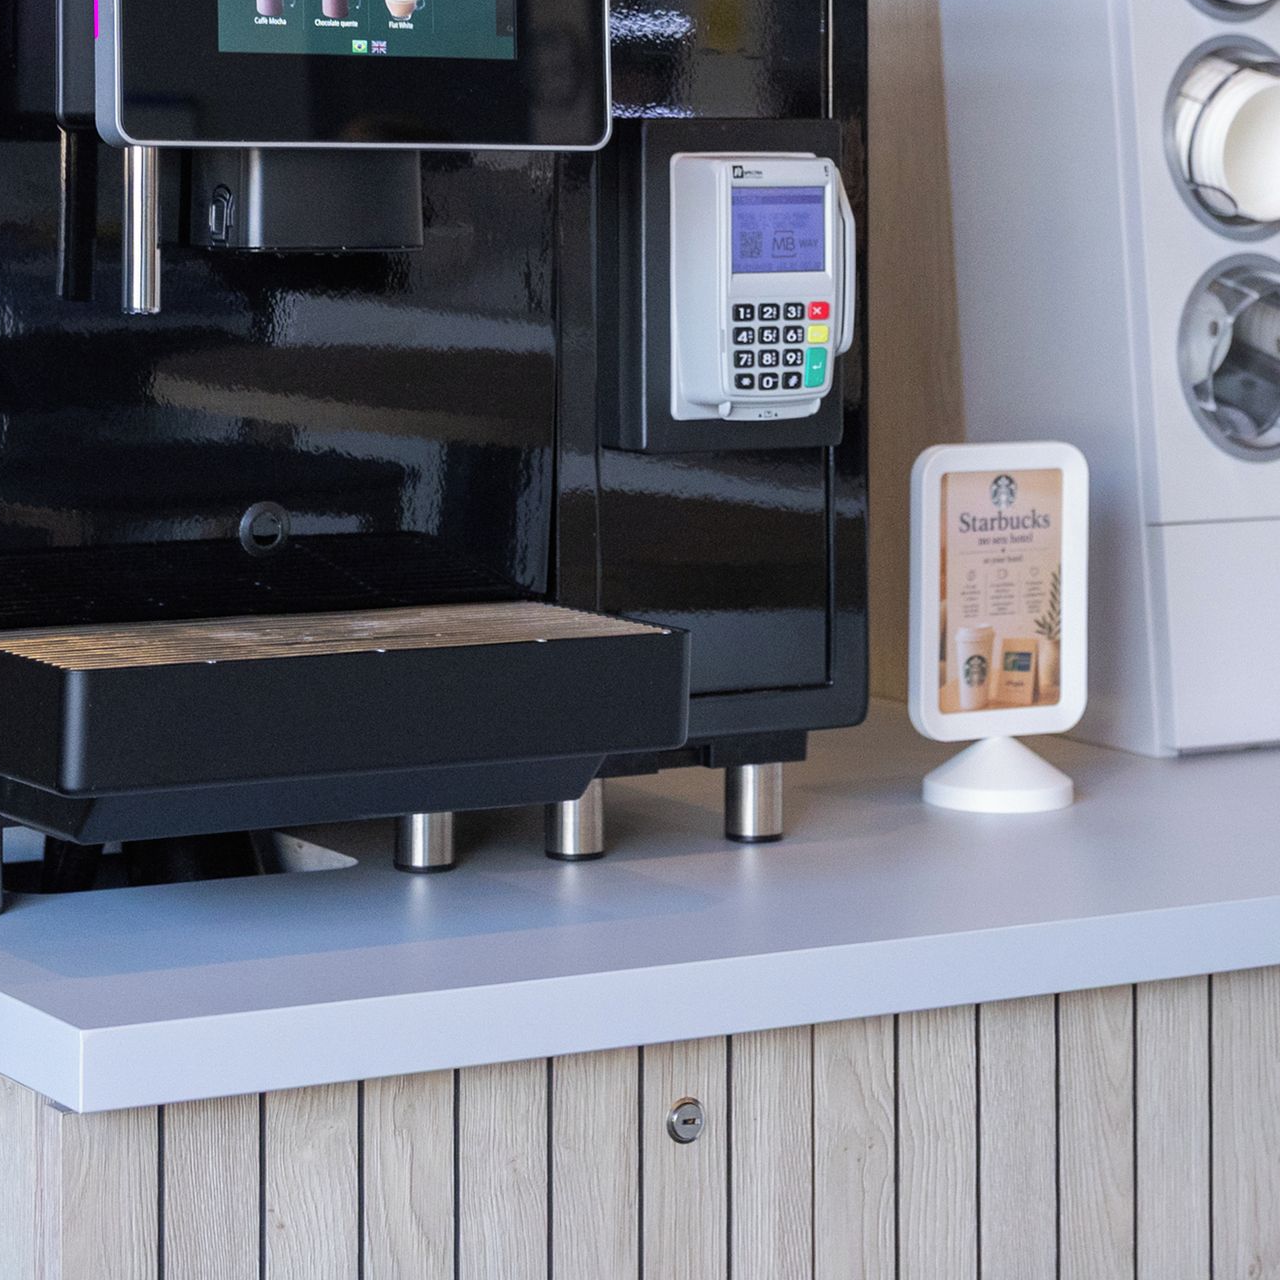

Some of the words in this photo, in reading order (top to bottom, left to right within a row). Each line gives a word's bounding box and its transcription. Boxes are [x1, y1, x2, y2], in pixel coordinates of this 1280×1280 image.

[269, 18, 287, 26] Mocha
[314, 19, 340, 27] Chocolate
[772, 237, 796, 251] MB
[738, 307, 744, 319] 1
[763, 306, 773, 318] 2
[787, 306, 796, 318] 3
[737, 331, 748, 343] 4
[763, 329, 772, 342] 5
[787, 330, 796, 342] 6
[739, 354, 747, 366] 7
[762, 353, 772, 365] 8
[786, 352, 796, 364] 9
[762, 376, 773, 388] 0
[959, 508, 1051, 533] Starbucks
